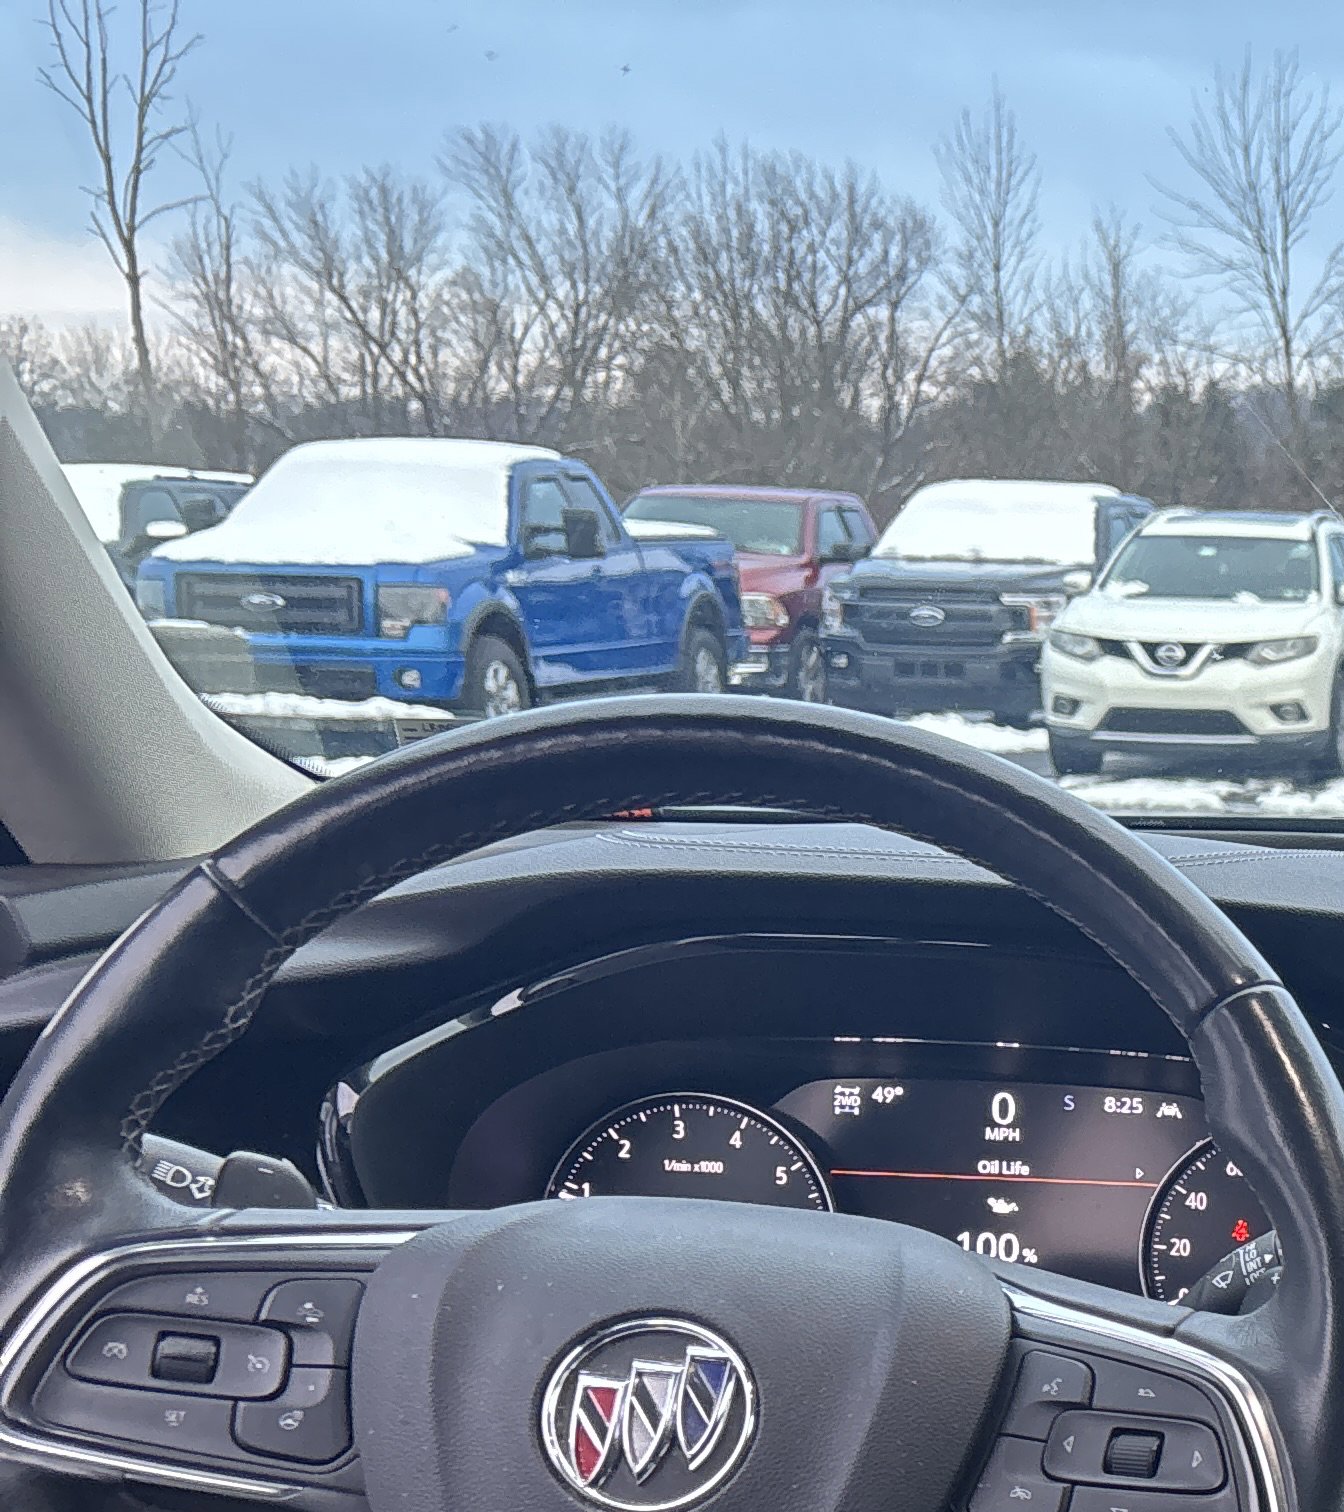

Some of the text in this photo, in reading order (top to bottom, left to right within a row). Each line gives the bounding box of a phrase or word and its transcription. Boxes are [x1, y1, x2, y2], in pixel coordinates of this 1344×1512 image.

[833, 1094, 861, 1107] 2WD
[991, 1091, 1017, 1126] 0
[1063, 1094, 1075, 1111] S
[1103, 1097, 1143, 1115] 8:25
[672, 1120, 685, 1139] 3
[984, 1127, 1020, 1142] MPH
[729, 1130, 742, 1148] 4
[617, 1139, 631, 1158] 2
[663, 1159, 724, 1174] 1/min x1000
[775, 1166, 788, 1185] 5
[977, 1160, 1030, 1176] Oil Life
[581, 1182, 591, 1198] 1
[1184, 1191, 1207, 1211] 40
[1169, 1238, 1191, 1257] 20
